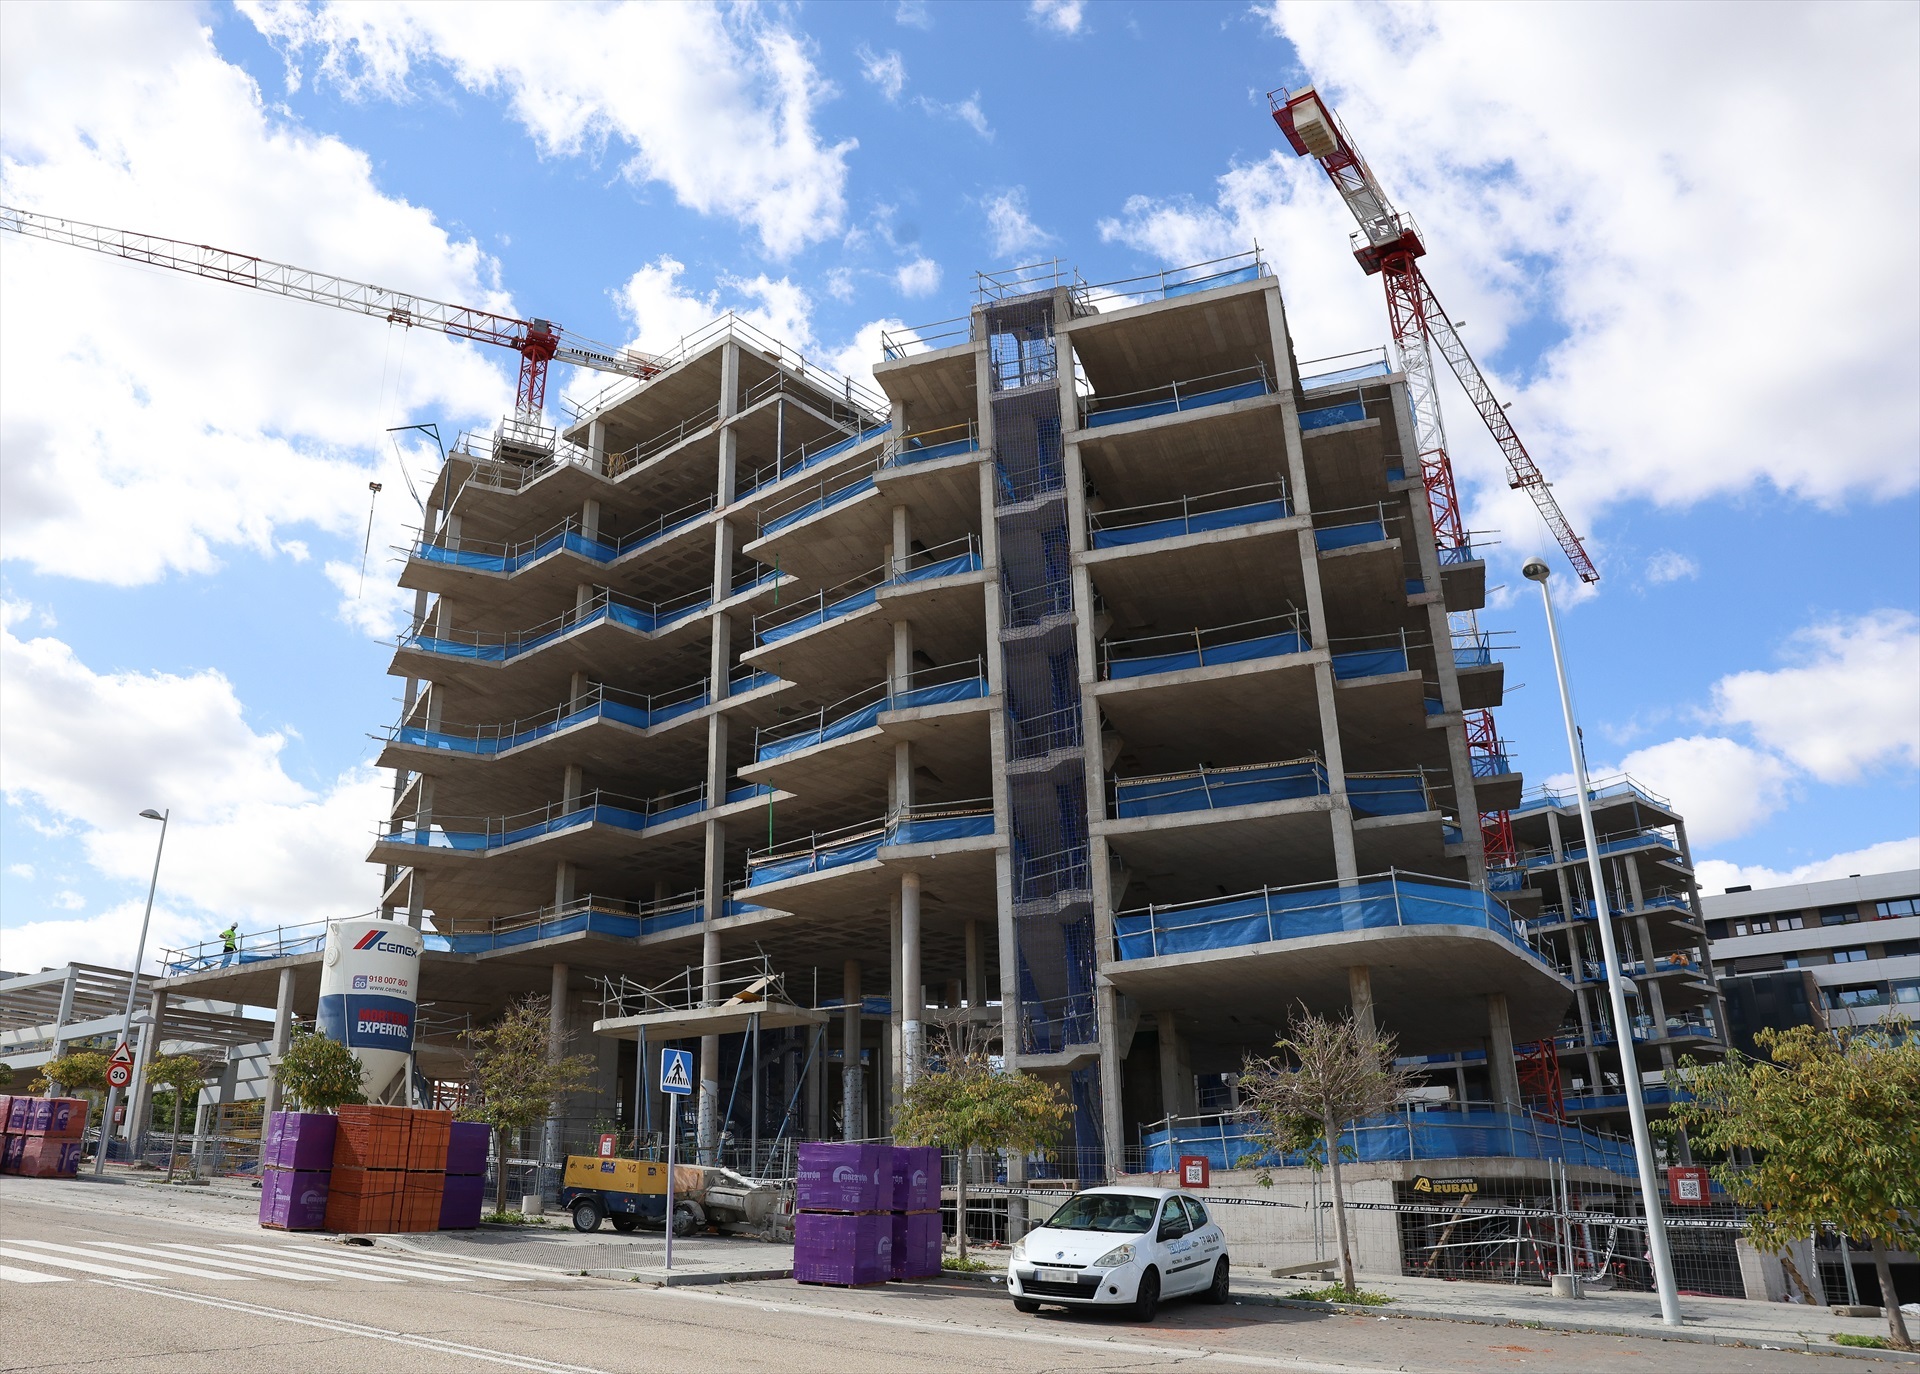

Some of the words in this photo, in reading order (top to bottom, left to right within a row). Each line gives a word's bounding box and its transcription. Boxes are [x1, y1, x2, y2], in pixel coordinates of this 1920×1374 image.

[571, 348, 615, 363] LIEBHERR
[378, 942, 417, 958] CEMEX
[369, 975, 383, 983] 918
[384, 977, 397, 985] 007
[359, 1009, 408, 1025] MORTERO
[112, 1071, 126, 1080] 30
[628, 1163, 637, 1173] 42
[1433, 1183, 1478, 1193] RUBAU
